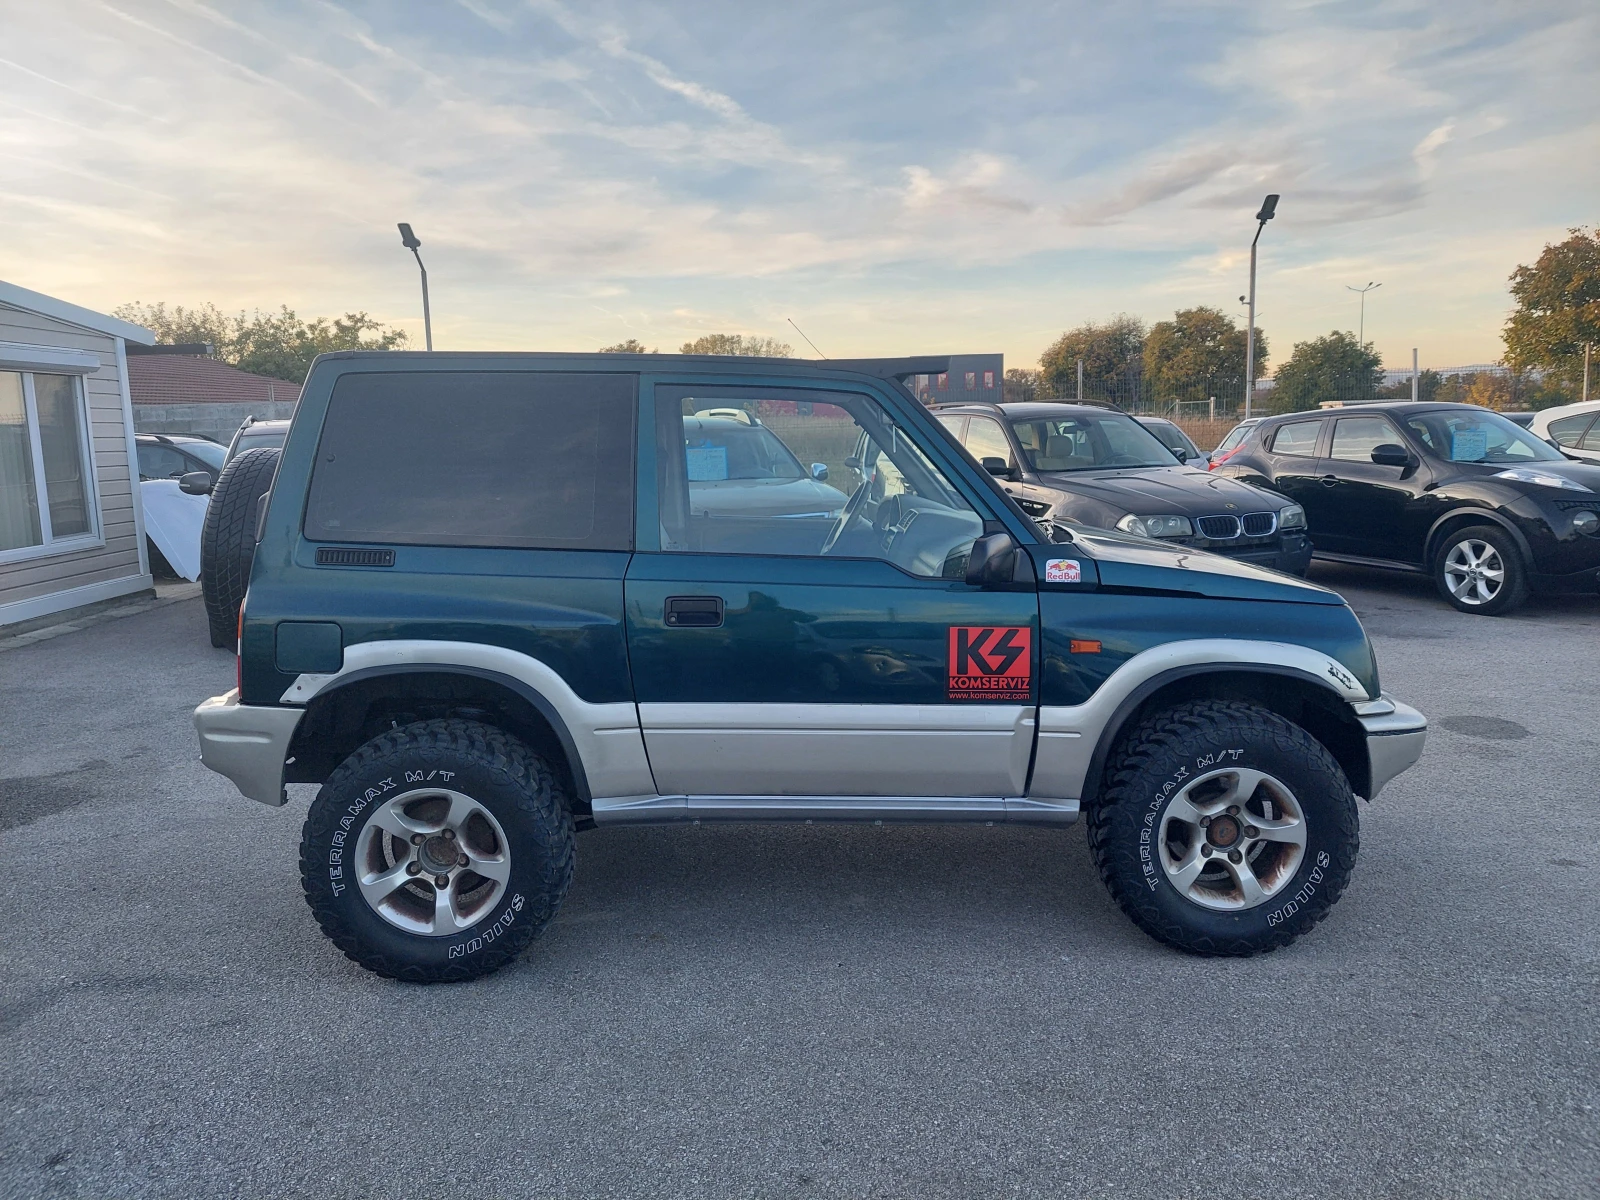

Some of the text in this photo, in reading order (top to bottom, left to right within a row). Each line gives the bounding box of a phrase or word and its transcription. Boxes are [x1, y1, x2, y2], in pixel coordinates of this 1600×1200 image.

[949, 677, 1030, 689] KOMSERVIZ
[957, 628, 1025, 675] KS
[949, 691, 1030, 700] www.komserviz.com
[329, 770, 455, 896] TERRAMAX M/T
[1140, 749, 1243, 891] TERRAMAX M/T
[1267, 851, 1330, 926] SAILUN
[448, 893, 525, 958] SAILUN
